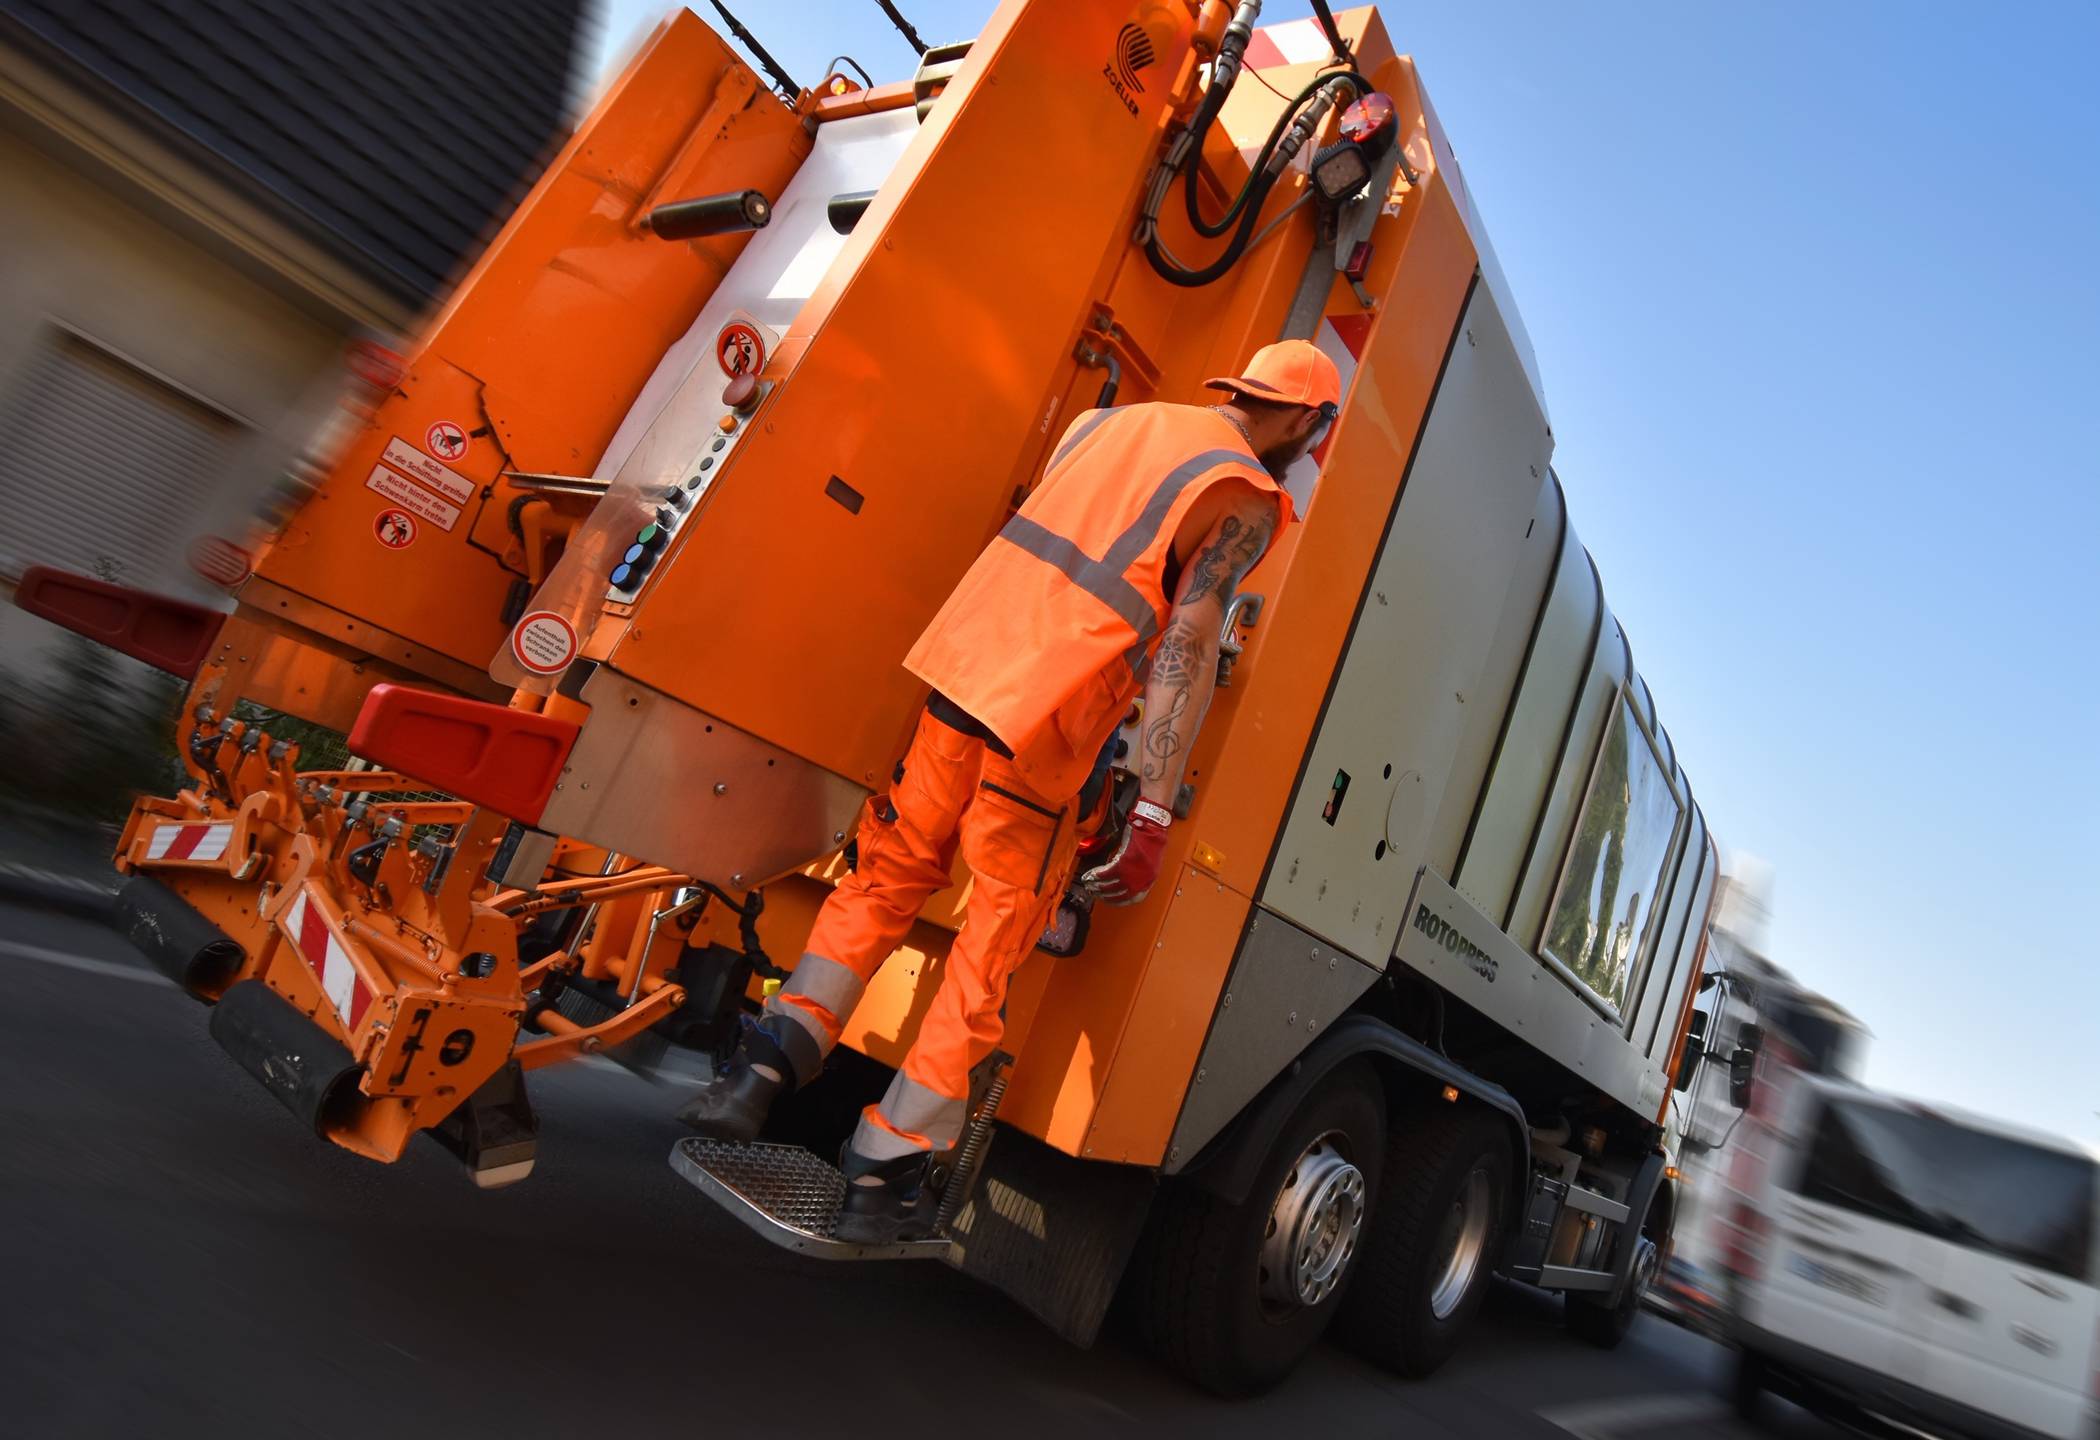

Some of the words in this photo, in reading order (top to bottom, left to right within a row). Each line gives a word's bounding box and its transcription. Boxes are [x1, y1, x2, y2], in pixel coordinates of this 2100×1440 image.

[1102, 64, 1139, 118] ZOELLER
[422, 459, 442, 475] Nicht
[374, 480, 424, 512] Schwenkarm
[424, 508, 447, 526] treten
[386, 474, 408, 491] Nicht
[408, 485, 432, 504] hinter
[431, 501, 447, 513] den
